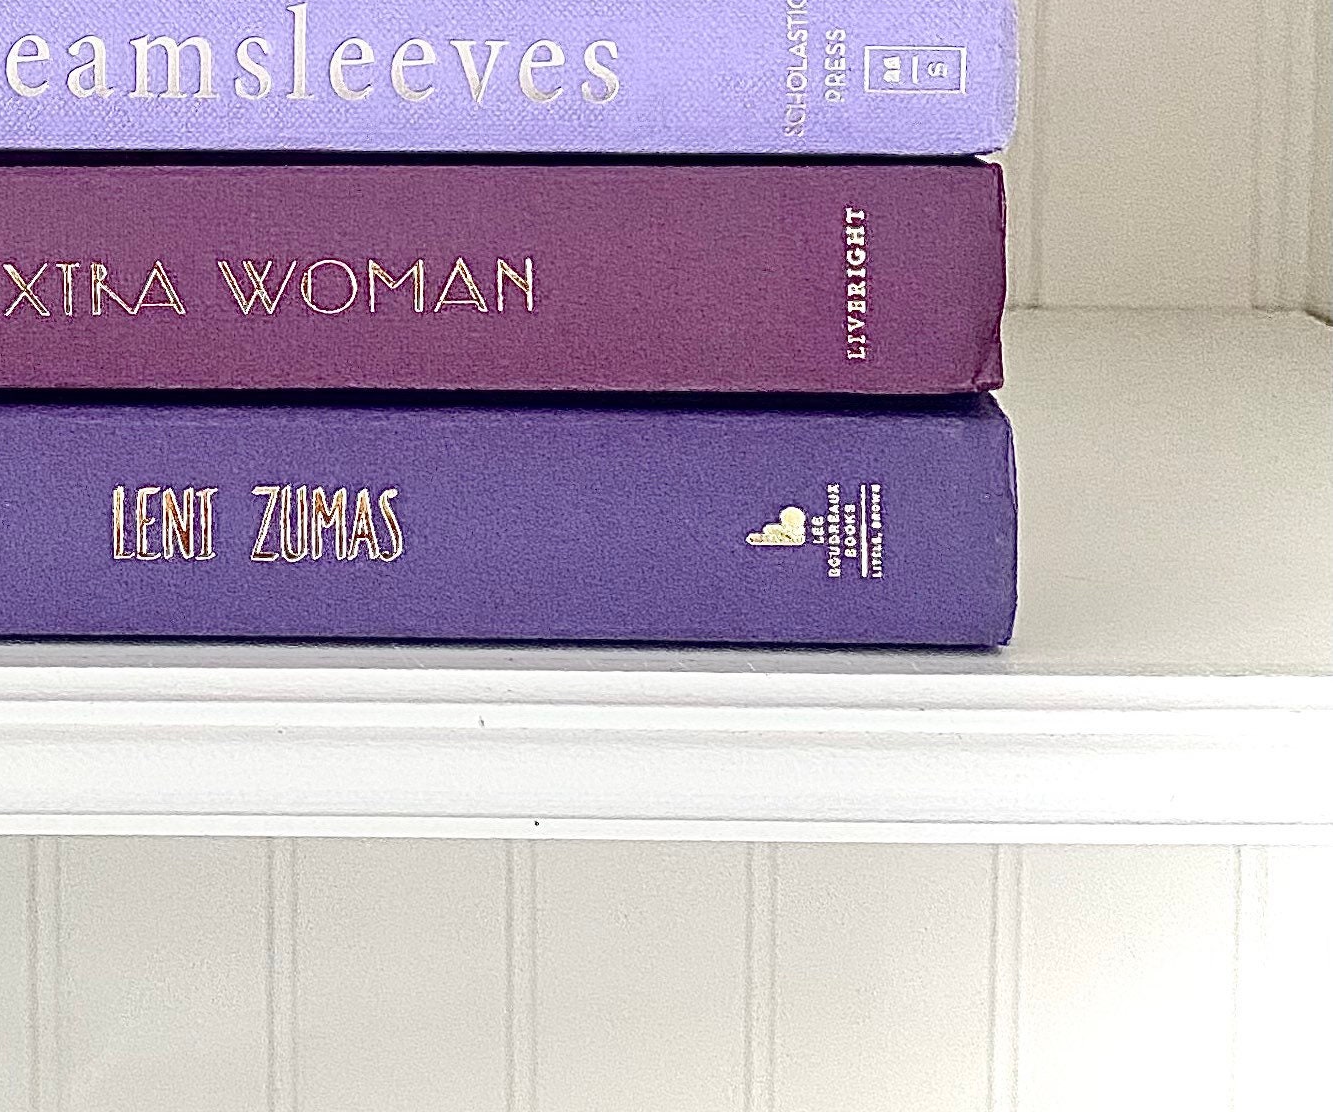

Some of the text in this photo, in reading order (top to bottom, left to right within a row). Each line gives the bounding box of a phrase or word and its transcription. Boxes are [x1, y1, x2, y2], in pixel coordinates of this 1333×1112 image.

[824, 28, 847, 104] PRESS
[217, 257, 533, 315] WOMAN
[845, 207, 866, 360] LIVERIGHT
[112, 484, 403, 563] LENI ZUMAS
[811, 516, 825, 544] LEE
[843, 504, 857, 558] BOOKS
